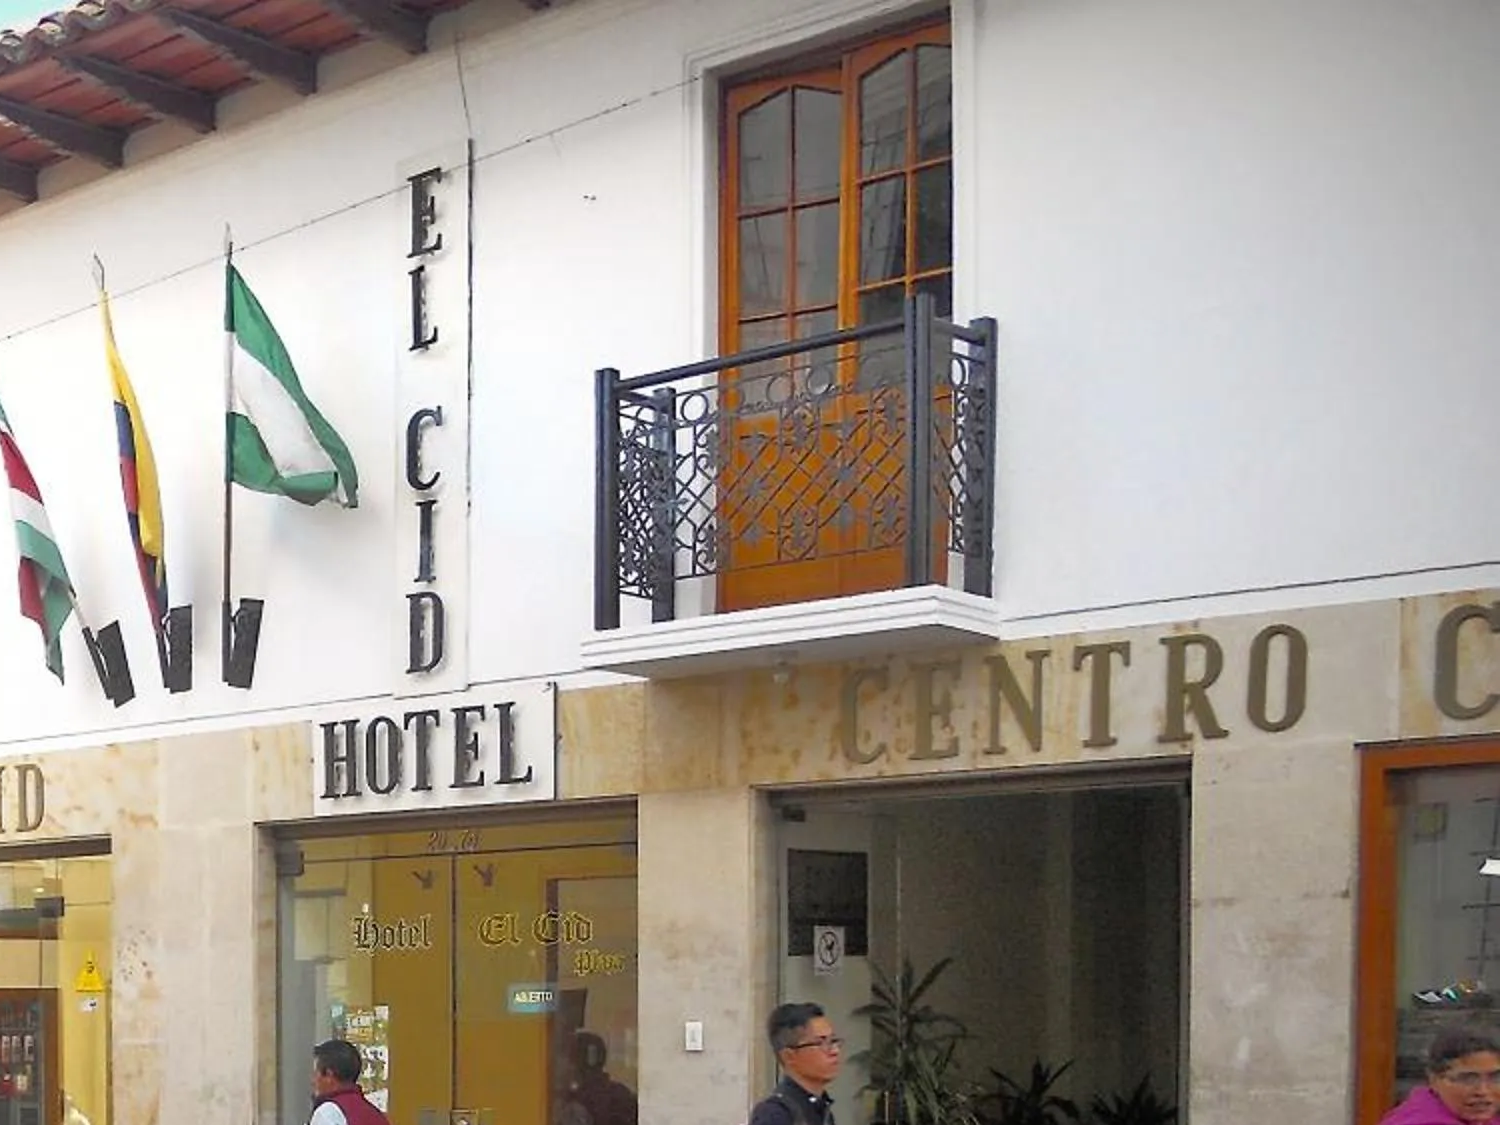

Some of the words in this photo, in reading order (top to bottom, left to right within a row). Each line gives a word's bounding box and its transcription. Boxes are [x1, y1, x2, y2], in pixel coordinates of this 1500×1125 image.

[407, 166, 443, 352] EL
[406, 405, 443, 675] CID
[318, 701, 533, 800] HOTEL
[842, 623, 1309, 764] CENTRO
[352, 909, 433, 956] Hotel
[477, 913, 522, 946] El
[531, 910, 593, 945] Cid
